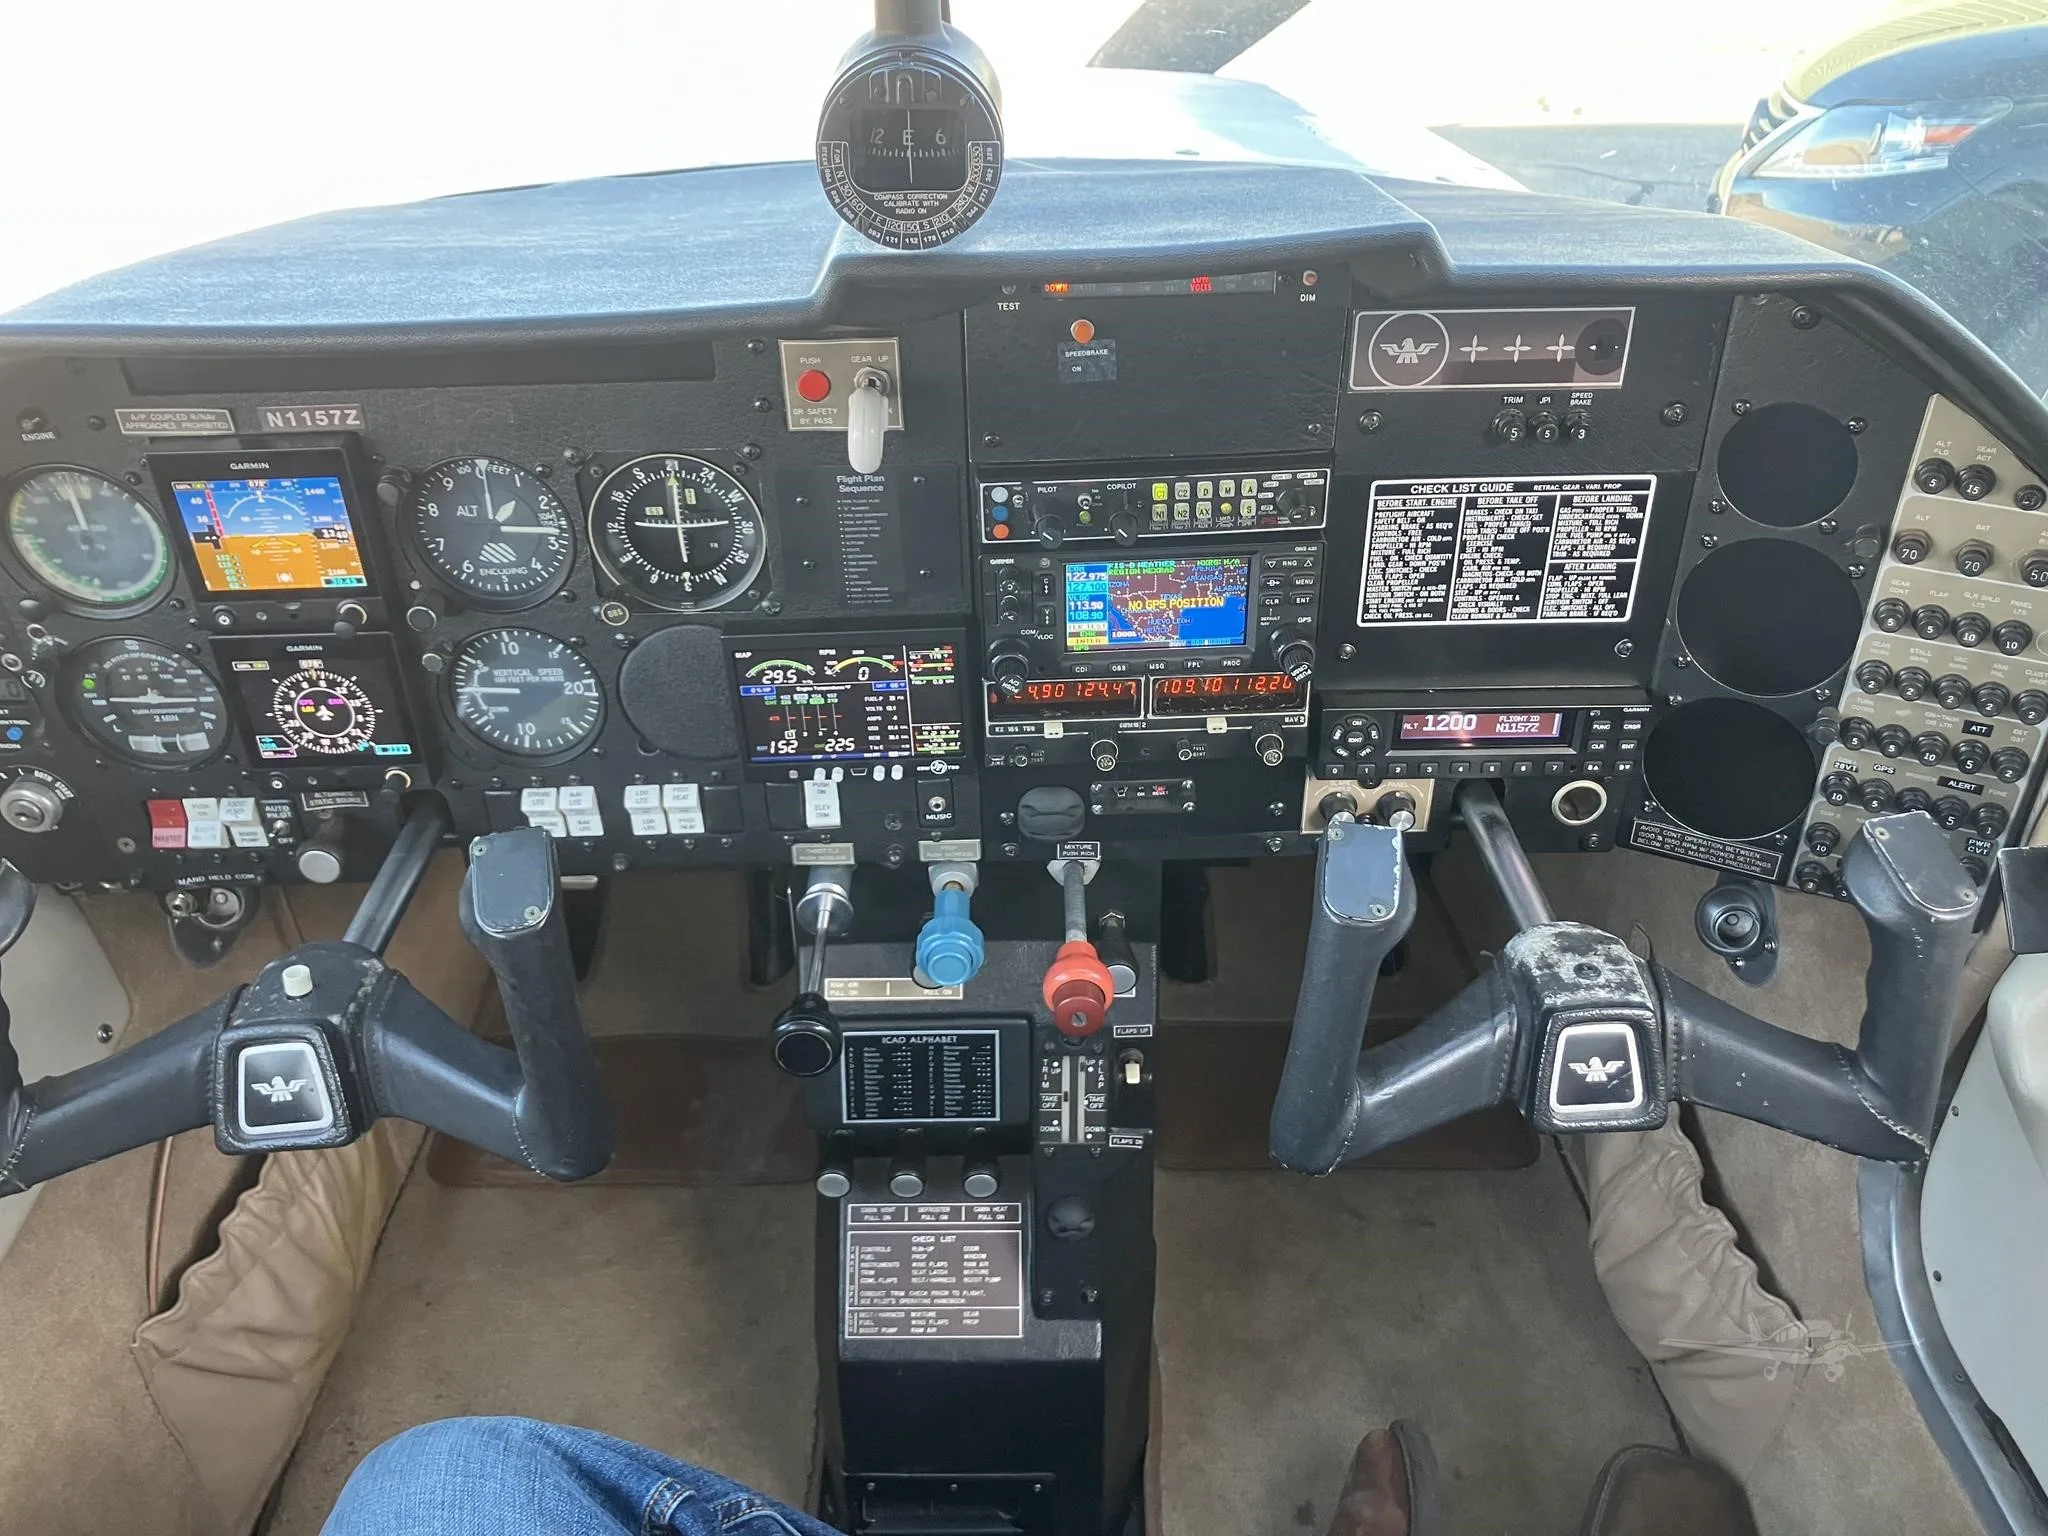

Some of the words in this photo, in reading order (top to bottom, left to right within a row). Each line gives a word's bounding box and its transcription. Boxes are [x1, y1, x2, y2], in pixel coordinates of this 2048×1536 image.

[903, 129, 914, 145] E
[935, 130, 946, 145] 6
[1044, 283, 1069, 292] DOWN
[1190, 282, 1213, 291] VOLTS
[1300, 293, 1316, 302] DIM
[998, 302, 1020, 311] TEST
[851, 355, 872, 363] GEAR
[878, 354, 889, 362] UP
[1065, 349, 1108, 358] SPEEDBRAKE
[1503, 396, 1524, 404] TRIM
[1539, 396, 1551, 404] JPI
[266, 409, 361, 428] N1157Z
[21, 431, 56, 441] ENGINE
[230, 461, 270, 470] GARMIN
[700, 467, 716, 481] 24
[443, 477, 454, 491] 9
[836, 475, 863, 485] Flight
[839, 484, 884, 494] Sequence
[1037, 486, 1057, 495] PILOT
[1107, 483, 1137, 493] COPILOT
[1410, 484, 1450, 495] CHECK
[1452, 483, 1477, 493] LIST
[1479, 483, 1514, 493] GUIDE
[1966, 484, 1980, 494] 15
[610, 489, 625, 503] 15
[728, 488, 746, 504] W
[1477, 497, 1504, 505] BEFORE
[1506, 496, 1524, 504] TAKE
[1525, 496, 1539, 504] OFF
[1573, 495, 1600, 503] BEFORE
[1601, 494, 1633, 502] LANDING
[538, 496, 549, 510] 2
[1430, 498, 1458, 506] ENGINE
[428, 503, 439, 517] 8
[457, 505, 478, 518] ALT
[607, 521, 620, 534] 12
[742, 520, 755, 535] 30
[1901, 548, 1918, 560] 70
[1224, 557, 1241, 565] N/A
[1964, 561, 1980, 571] 70
[480, 567, 528, 576] ENCODING
[1143, 567, 1175, 575] NEXRAD
[1564, 563, 1586, 571] AFTER
[1587, 562, 1617, 570] LANDING
[1067, 572, 1108, 582] 122.975
[1067, 583, 1107, 592] 127.100
[1069, 601, 1104, 611] 113.50
[1129, 600, 1144, 610] NO
[1146, 599, 1167, 609] GPS
[1169, 596, 1225, 608] POSITION
[1069, 611, 1104, 620] 108.90
[1963, 632, 1975, 642] 10
[501, 641, 520, 656] 10
[2005, 641, 2018, 650] 10
[493, 668, 533, 677] VERTICAL
[537, 667, 565, 676] SPEED
[762, 669, 798, 685] 29.5
[858, 667, 870, 681] 0
[563, 681, 584, 695] 20
[1077, 681, 1137, 698] 124.47
[1422, 714, 1478, 731] 1200
[1495, 722, 1540, 732] N1157Z
[518, 722, 536, 736] 10
[1970, 724, 1987, 734] ATT
[770, 739, 799, 754] 152
[824, 737, 856, 752] 225
[1923, 753, 1936, 761] 10
[1873, 764, 1894, 774] GPS
[1947, 780, 1977, 790] ALERT
[267, 811, 292, 819] PILOT
[926, 812, 952, 820] MUSIC
[1639, 825, 1660, 834] AVOID
[1662, 830, 1682, 839] CONT.
[1684, 835, 1724, 850] OPERATION
[1725, 845, 1760, 859] BETWEEN
[1968, 839, 1990, 848] PWR
[1636, 837, 1661, 848] BELOW
[1687, 850, 1724, 863] MANIFOLD
[1725, 859, 1761, 873] PRESSURE
[1638, 832, 1655, 840] 1500
[1681, 842, 1698, 851] RPM
[1709, 848, 1735, 860] POWER
[1736, 855, 1772, 869] SETTINGS
[1967, 847, 1988, 855] CVT
[881, 1036, 906, 1044] ICAO
[910, 1035, 958, 1043] ALPHABET
